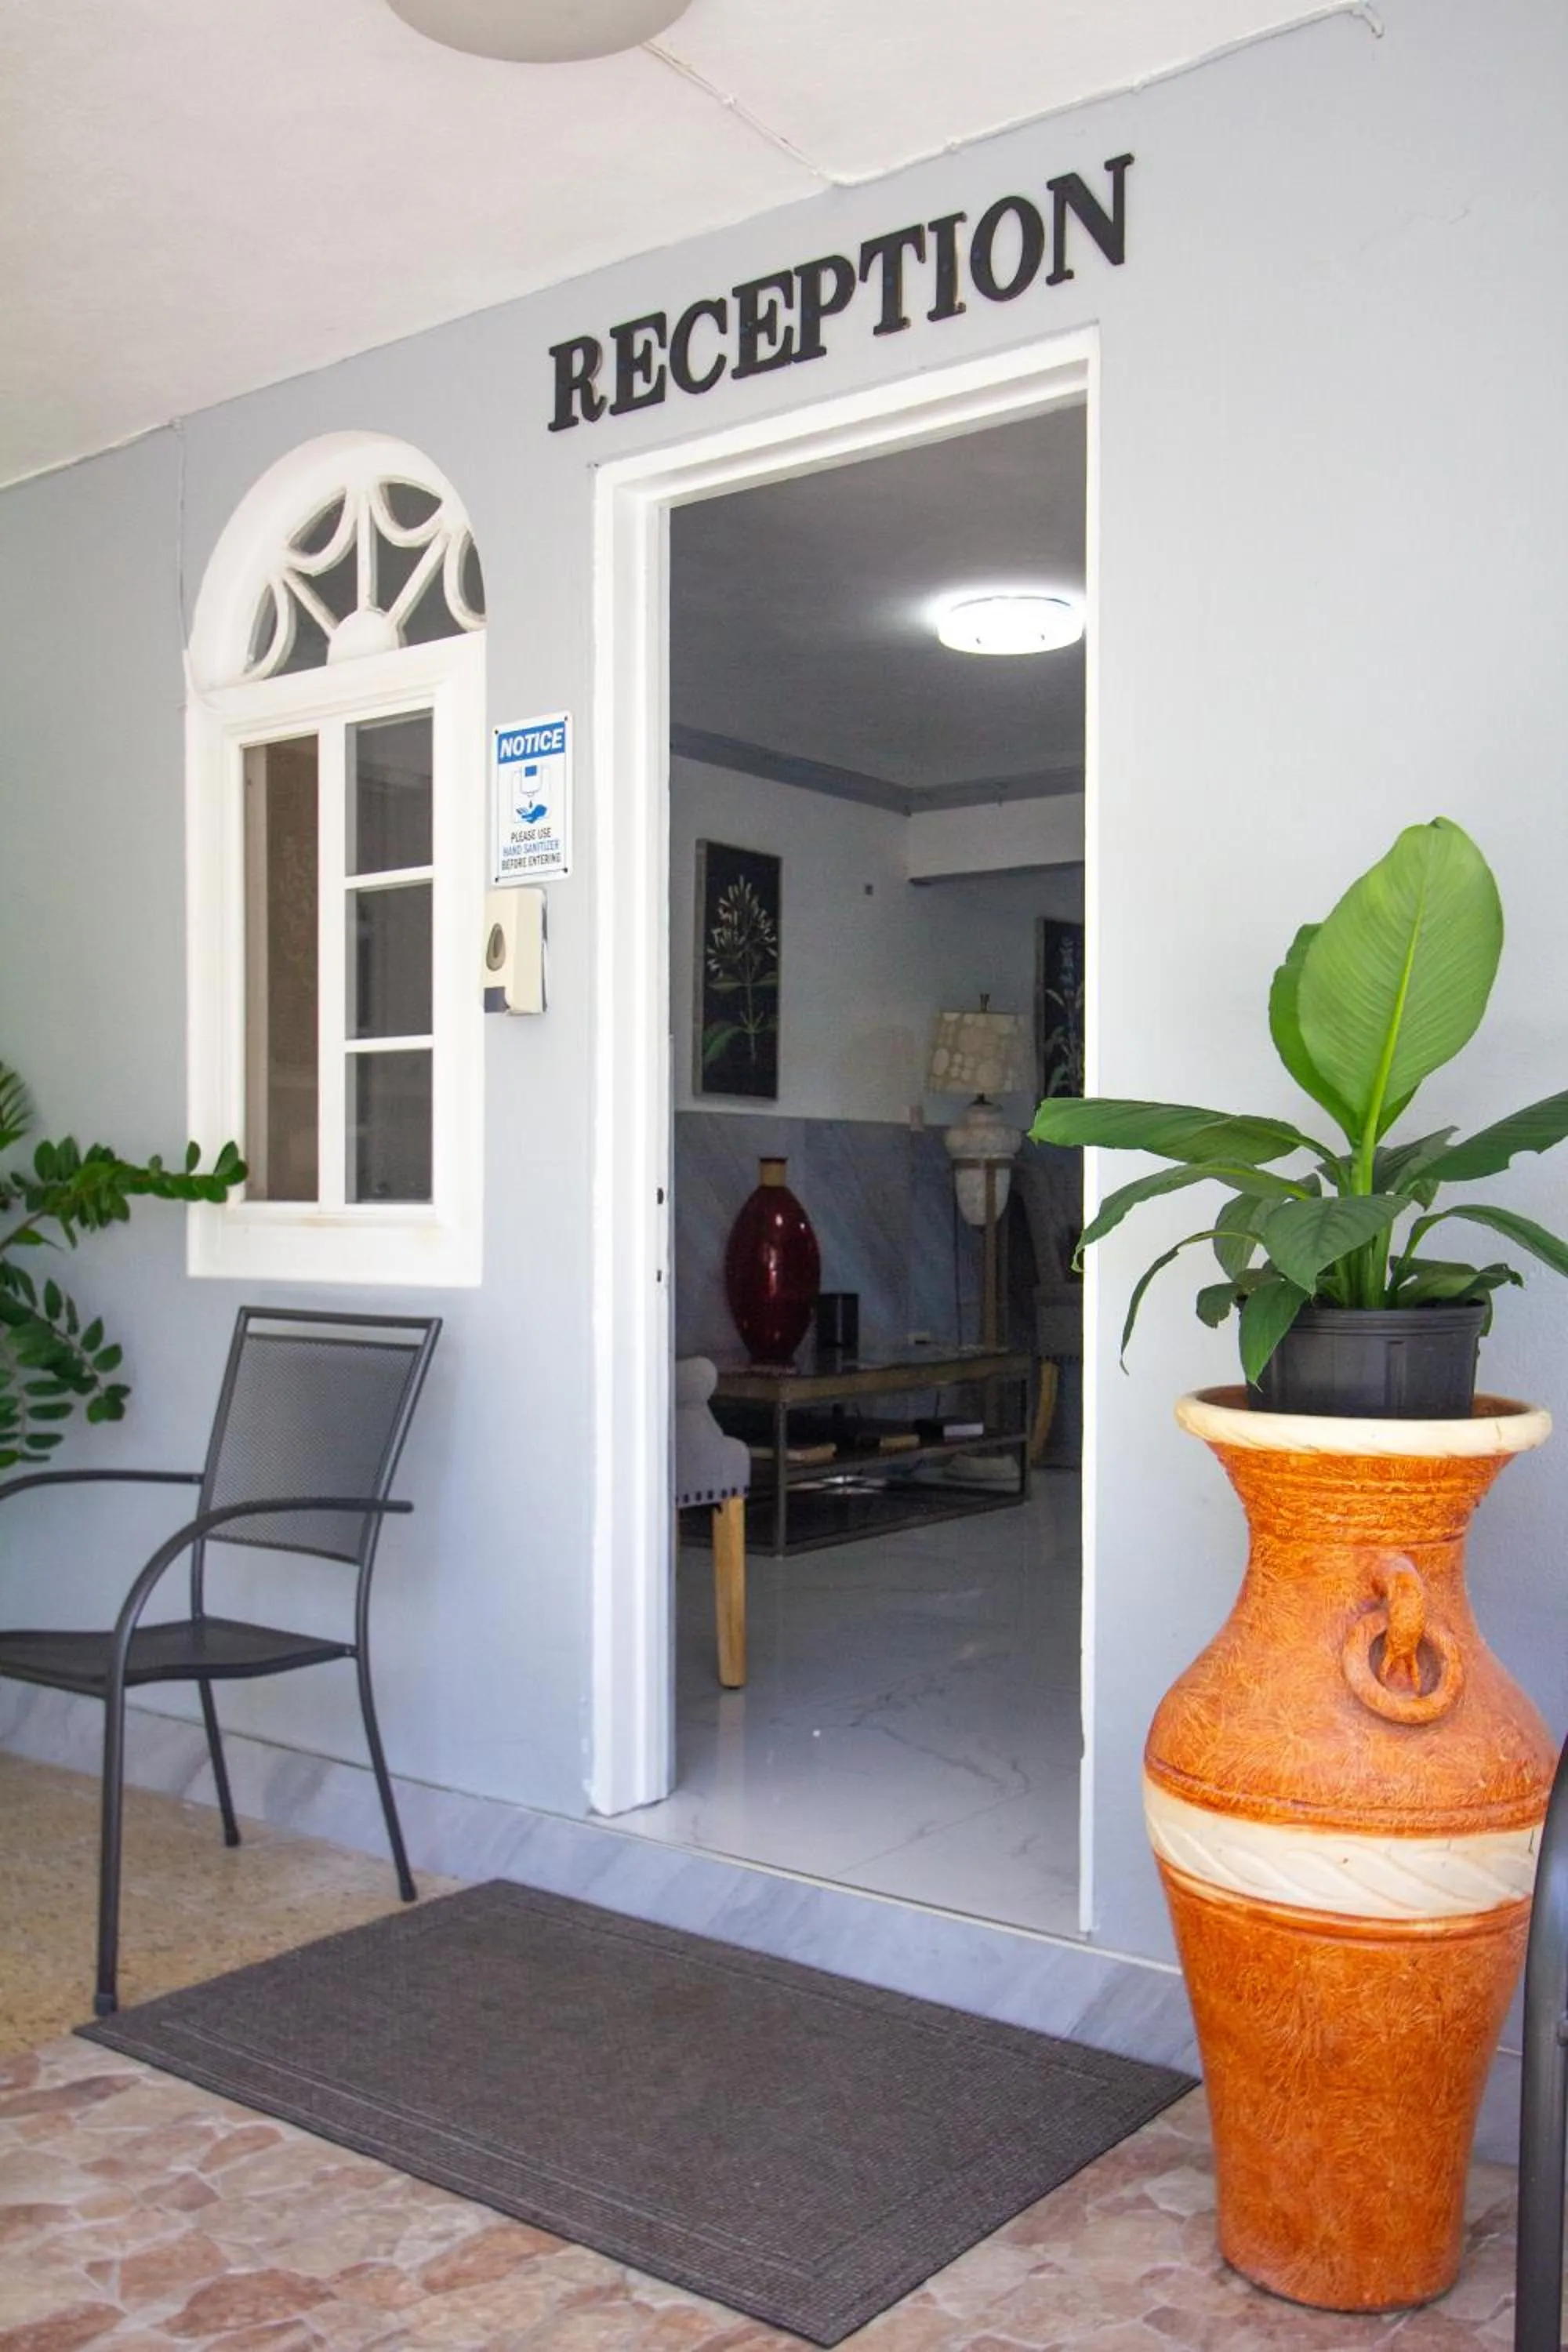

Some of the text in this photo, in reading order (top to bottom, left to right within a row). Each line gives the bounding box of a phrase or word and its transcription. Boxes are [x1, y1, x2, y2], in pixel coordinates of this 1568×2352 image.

[548, 153, 1134, 432] RECEPTION
[500, 728, 564, 758] NOTICE
[510, 827, 551, 844] PLEASE USE
[503, 840, 560, 857] HAND SANITIZER
[501, 852, 561, 870] BEFORE ENTERING
